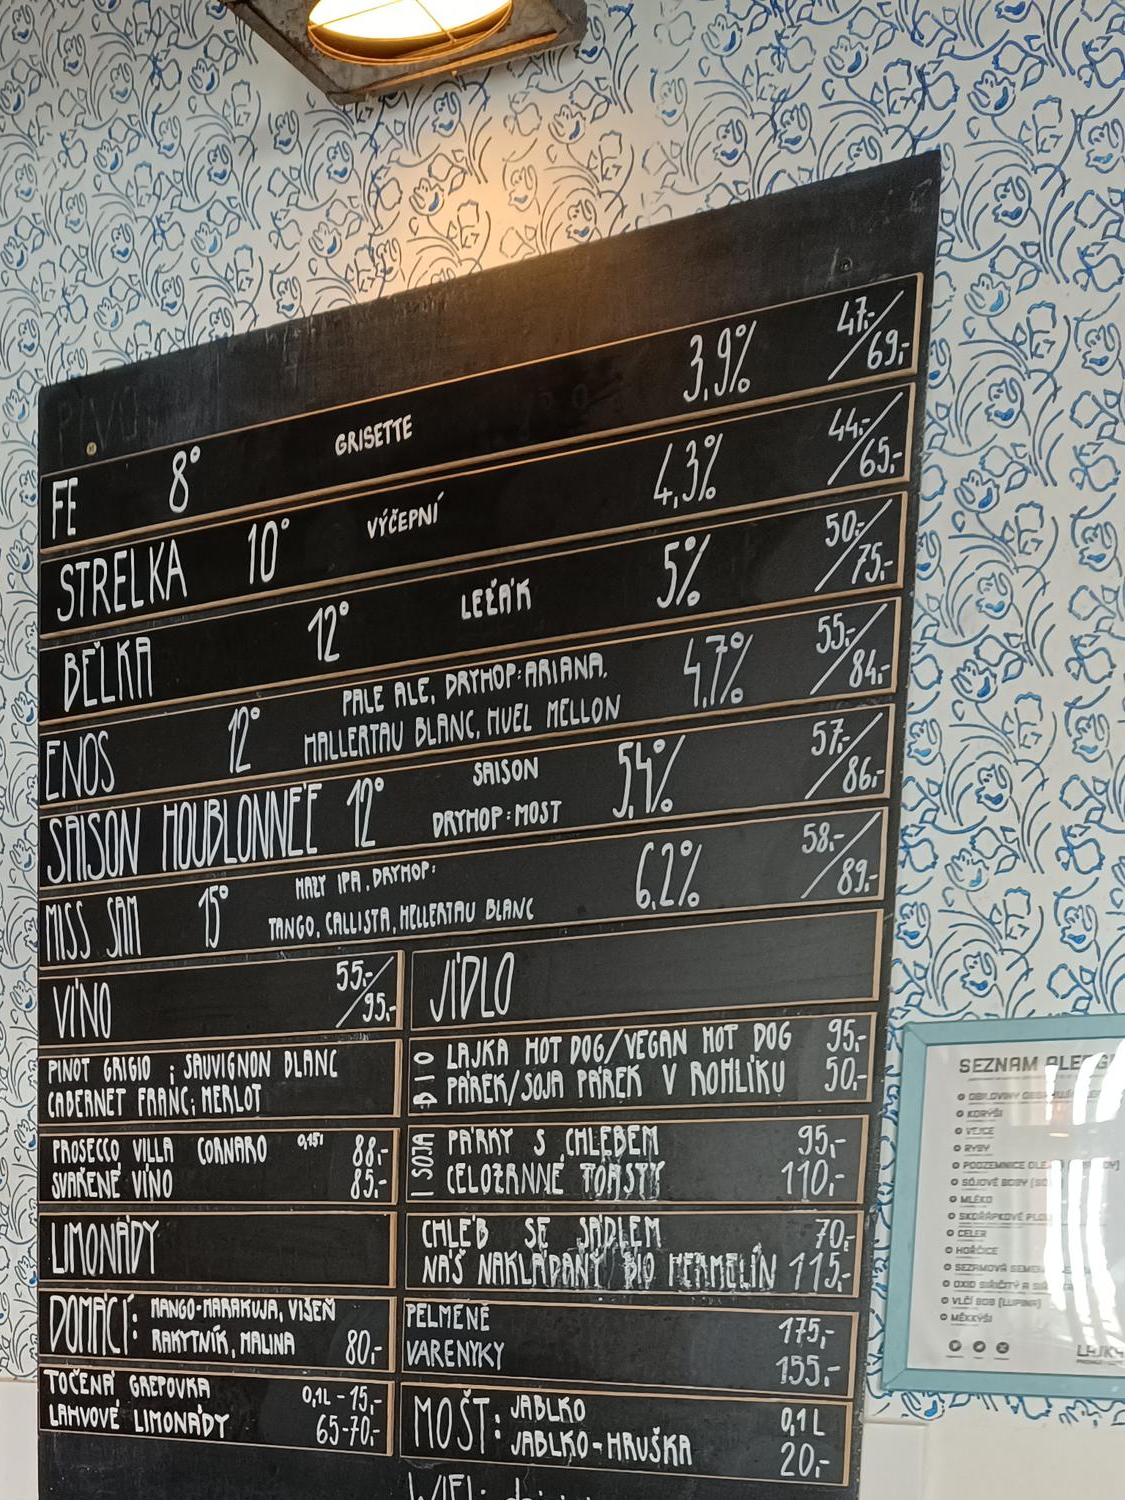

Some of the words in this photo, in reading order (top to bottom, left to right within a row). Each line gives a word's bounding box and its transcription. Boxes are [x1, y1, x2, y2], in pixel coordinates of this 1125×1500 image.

[52, 477, 78, 539] FE
[335, 414, 413, 456] GRISETTE
[683, 320, 757, 401] 3,9%
[57, 539, 187, 622] STRELKA
[367, 491, 444, 539] VÝČEPNÍ
[654, 433, 723, 509] 4,3%
[64, 637, 153, 712] BĚLKA
[461, 577, 532, 620] LEŽÁK
[657, 534, 711, 608] 5%
[343, 685, 385, 716] PALE
[394, 677, 435, 708] ALE,
[683, 632, 754, 709] 4,7%
[304, 721, 404, 765] HALLERTAU
[415, 710, 480, 748] BLANC,
[487, 703, 532, 736] HUEL
[546, 694, 621, 729] MELLON
[46, 730, 115, 801] ENOS
[47, 807, 141, 884] SAISON
[473, 757, 539, 786] SAISON
[612, 735, 686, 819] 5,4%
[295, 874, 326, 900] HAZY
[636, 840, 702, 910] 6,2%
[46, 900, 92, 962] MISS
[106, 895, 142, 957] SAM
[268, 915, 321, 941] TANGO,
[400, 901, 476, 930] HELLERTAU
[485, 897, 535, 922] BLANC
[53, 977, 111, 1039] VÍNO
[429, 951, 515, 1023] JÍDLO
[48, 1057, 90, 1084] PINOT
[103, 1055, 151, 1082] GRIGIO
[183, 1050, 271, 1080] SAUVIGNON
[284, 1049, 338, 1079] BLANC
[447, 1038, 509, 1069] LAJKA
[525, 1036, 563, 1066] HOT
[703, 1024, 739, 1054] HOT
[754, 1021, 792, 1052] DOG
[959, 1056, 1038, 1073] SEZNAM
[577, 1064, 643, 1099] PÁREK
[662, 1063, 677, 1095] V
[690, 1054, 786, 1096] ROHLÍKU
[48, 1087, 126, 1118] CABERNET
[201, 1084, 262, 1115] MERLOT
[52, 1136, 120, 1164] PROSECCO
[132, 1136, 174, 1164] VILLA
[197, 1134, 268, 1165] CORNARO
[448, 1126, 513, 1156] PÁRKY
[533, 1128, 546, 1156] S
[566, 1125, 659, 1156] CHLEBEM
[51, 1164, 121, 1199] SVAŘENÉ
[132, 1164, 173, 1202] VÍNO
[51, 1214, 160, 1276] LIMONÁDY
[421, 1215, 490, 1249] CHLÉB
[524, 1216, 551, 1249] SE
[577, 1214, 662, 1250] SÁDLEM
[422, 1248, 467, 1285] NÁŠ
[668, 1242, 777, 1291] HERMELÍN
[240, 1330, 295, 1356] MALINA
[406, 1339, 505, 1371] VARENYKY
[43, 1369, 116, 1396] TOČENÁ
[129, 1370, 211, 1399] GREPOVKA
[48, 1399, 120, 1431] LAHVOVÉ
[133, 1404, 230, 1438] LIMONÁDY
[510, 1394, 586, 1424] JABLKO
